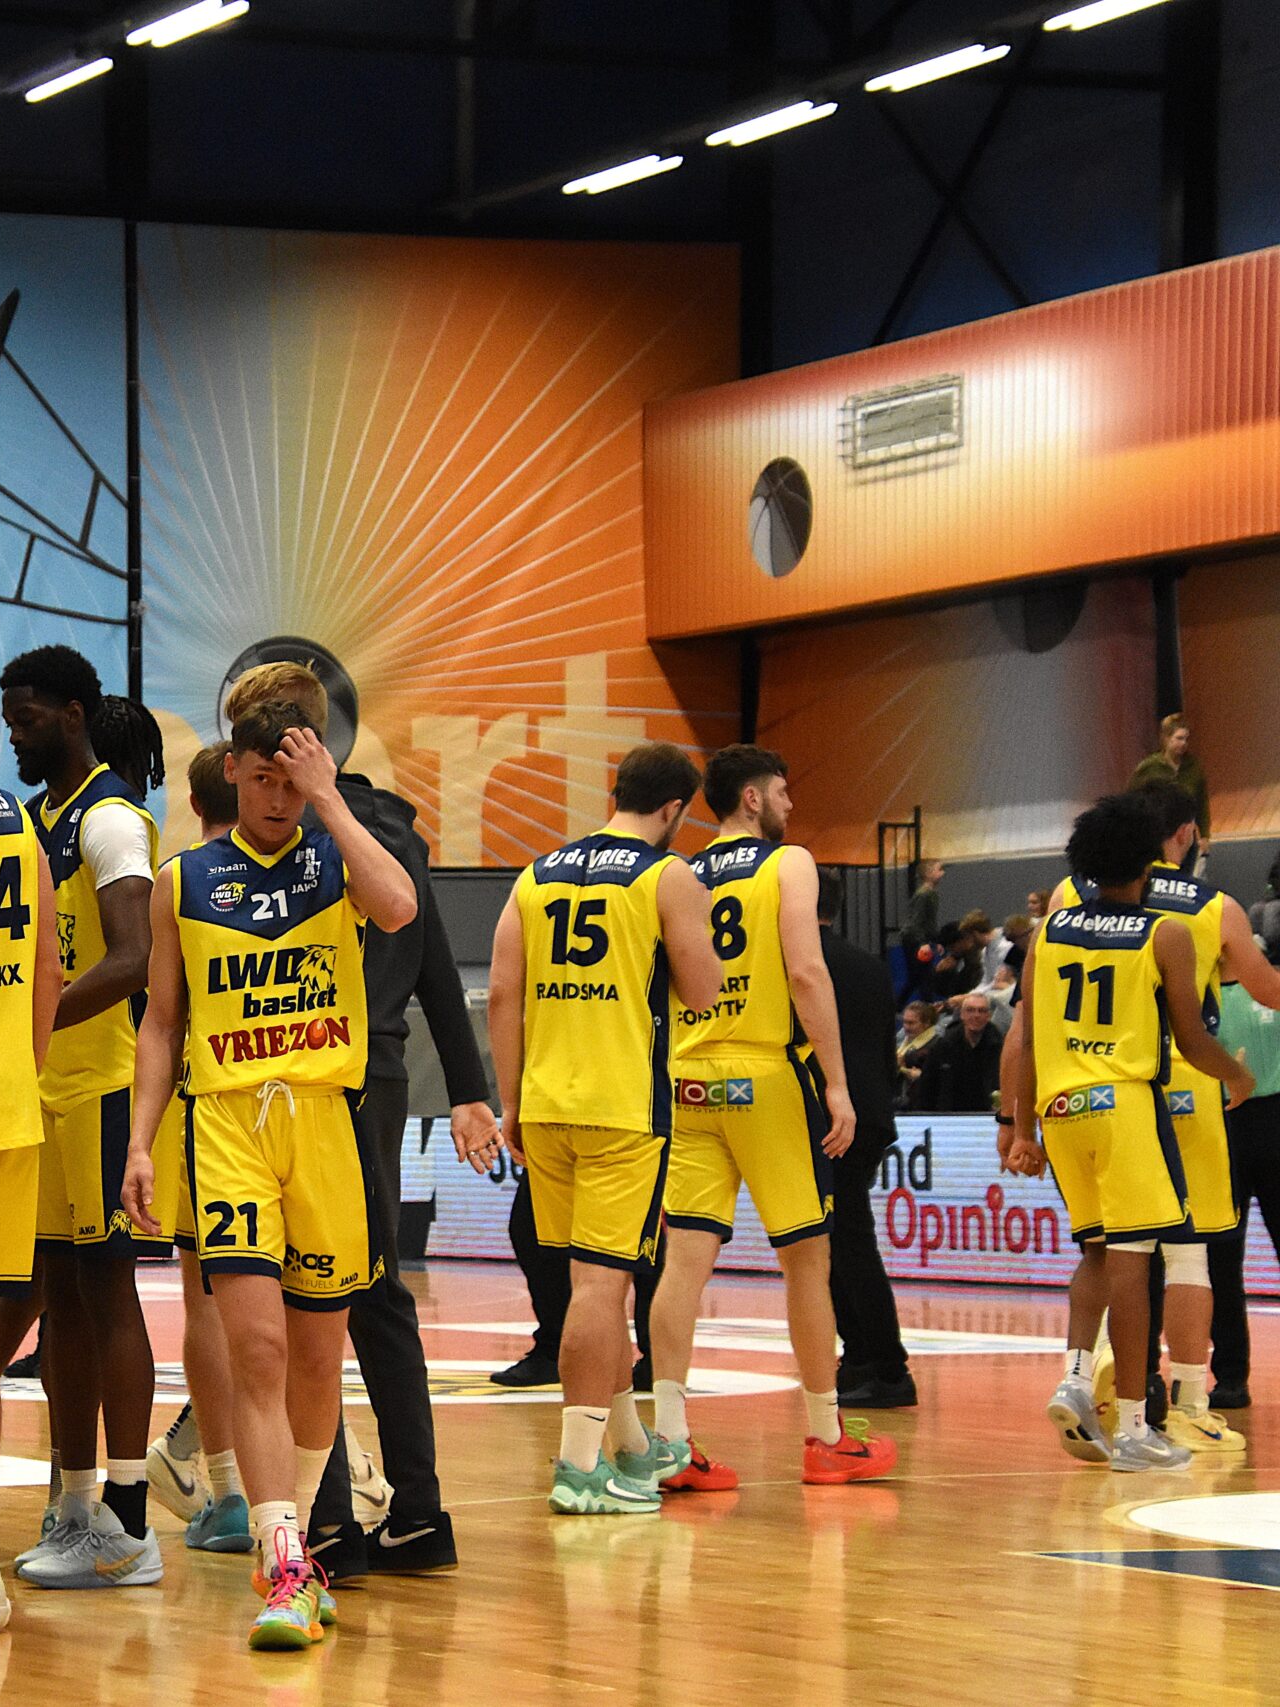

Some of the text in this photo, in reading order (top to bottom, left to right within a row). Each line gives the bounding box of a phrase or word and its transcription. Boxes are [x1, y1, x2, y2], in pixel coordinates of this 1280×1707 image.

[588, 848, 641, 869] VRIES
[210, 890, 232, 900] LWD
[250, 889, 290, 921] 21
[1151, 878, 1199, 898] RIES
[544, 898, 609, 967] 15
[1071, 911, 1095, 931] de
[1094, 914, 1148, 932] VRIES
[208, 947, 305, 995] LWD
[243, 983, 338, 1019] basket
[1058, 962, 1115, 1026] 11
[208, 1016, 351, 1066] VRIEZON
[204, 1201, 259, 1248] 21
[886, 1183, 1061, 1268] Opinion
